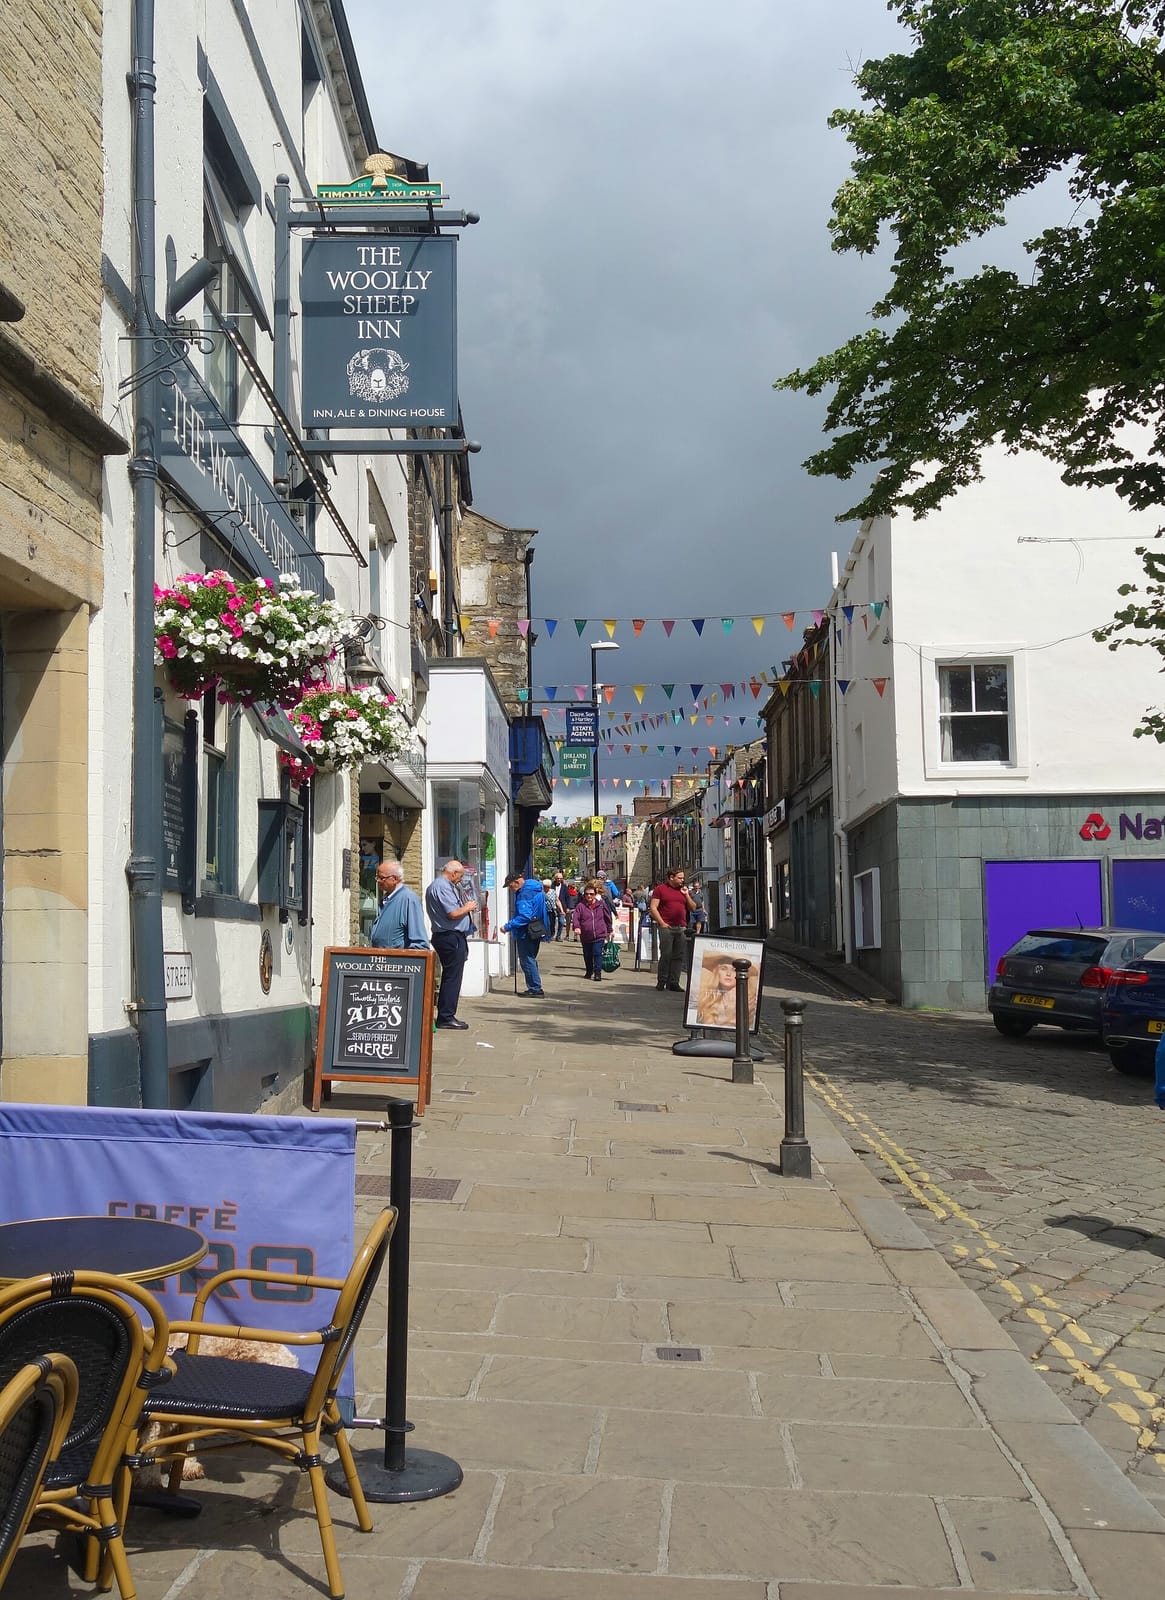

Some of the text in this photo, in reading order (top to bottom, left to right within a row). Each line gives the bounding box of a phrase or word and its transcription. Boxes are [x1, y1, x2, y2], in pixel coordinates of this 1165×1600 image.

[320, 190, 376, 198] TIMOTHY
[357, 246, 402, 266] THE
[326, 270, 433, 290] WOOLLY
[343, 294, 415, 315] SHEEP
[357, 319, 402, 339] INN
[358, 409, 365, 418] &
[368, 408, 407, 417] DINING
[410, 408, 446, 417] HOUSE
[171, 383, 207, 477] THE
[208, 429, 270, 555] WOOLLY
[335, 961, 421, 973] WOOLLY SHEEP INN
[369, 955, 387, 963] THE
[166, 966, 190, 987] STREET
[360, 982, 392, 992] ALL 6
[350, 992, 401, 1005] Timothy Taylor's
[346, 1004, 402, 1026] ALES
[370, 1033, 398, 1043] PERFECTLY
[347, 1042, 393, 1059] HERE!
[107, 1200, 239, 1232] CAFFÈ
